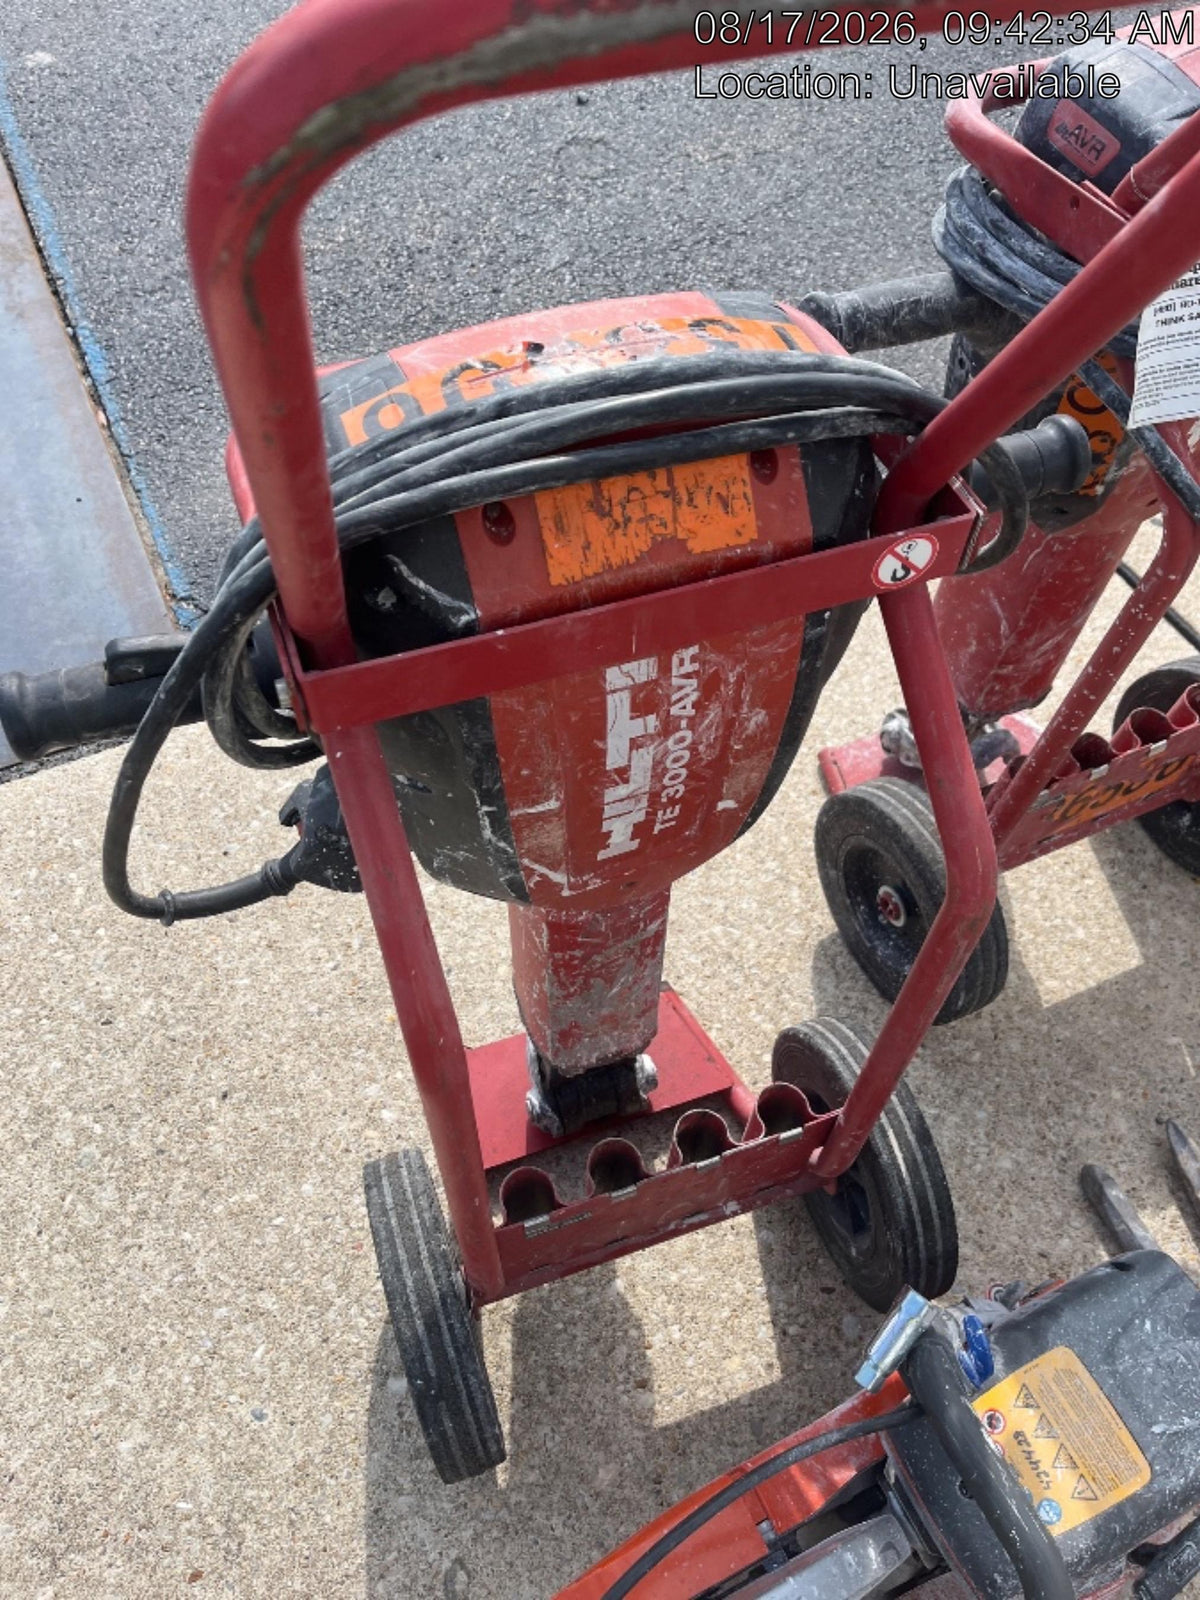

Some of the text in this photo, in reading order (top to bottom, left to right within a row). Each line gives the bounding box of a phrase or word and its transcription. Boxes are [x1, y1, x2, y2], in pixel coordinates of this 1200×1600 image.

[597, 655, 659, 862] HILTI
[652, 644, 700, 835] TE 3000-AVR
